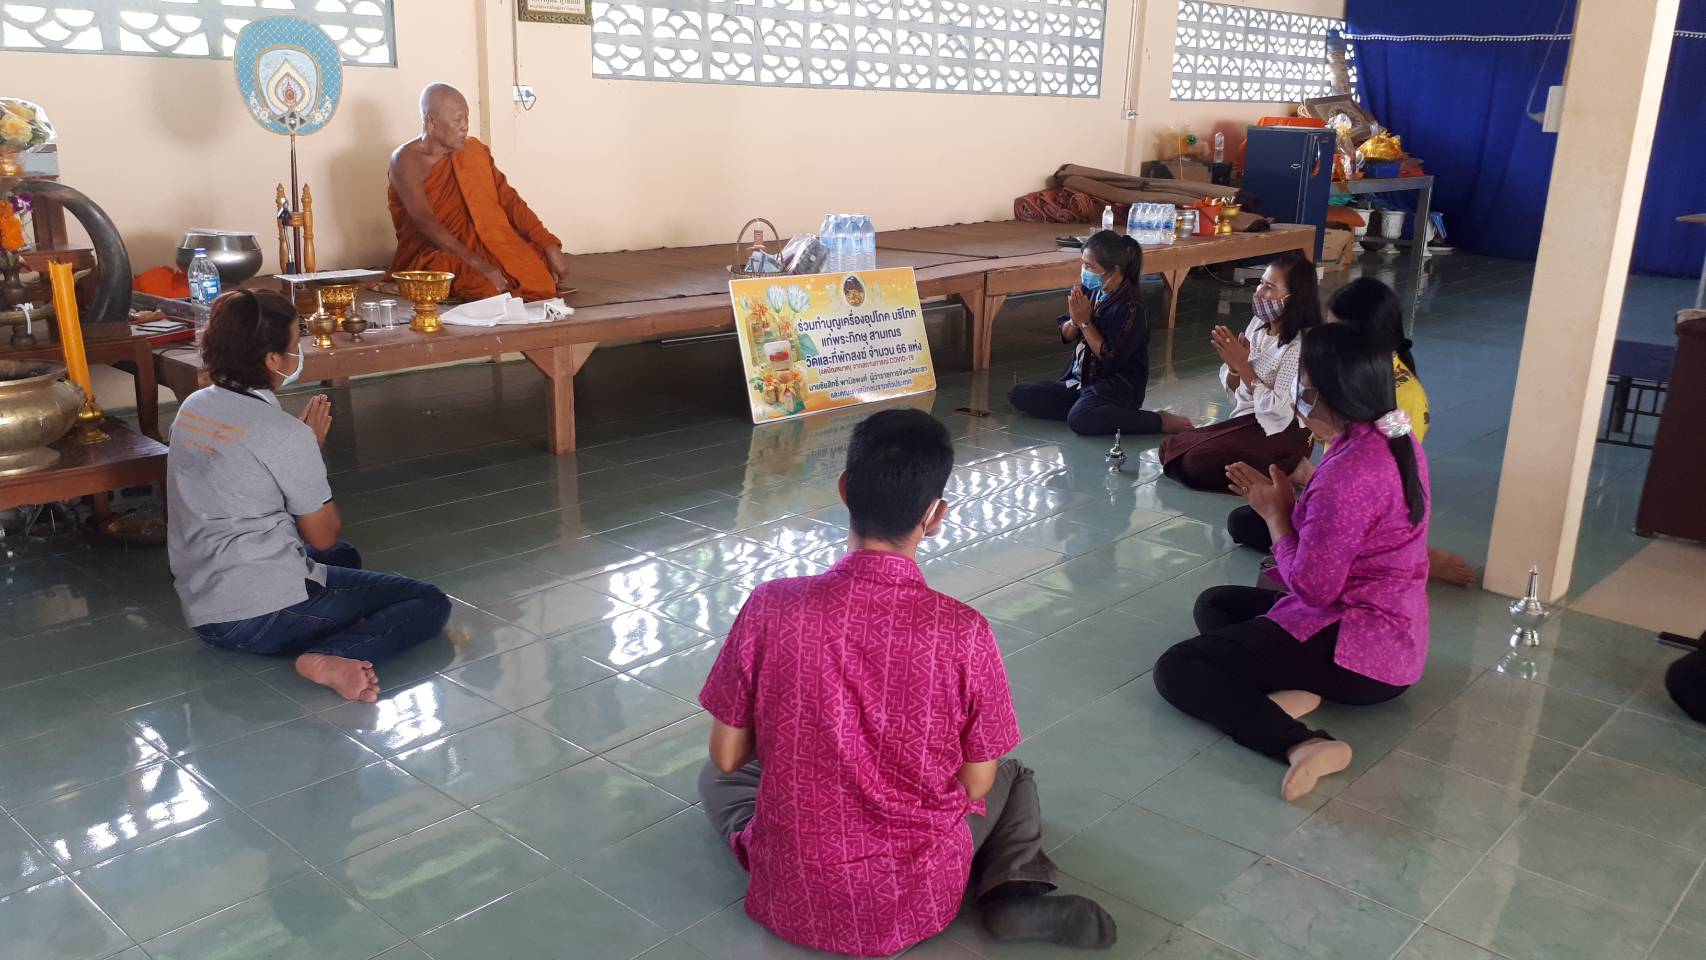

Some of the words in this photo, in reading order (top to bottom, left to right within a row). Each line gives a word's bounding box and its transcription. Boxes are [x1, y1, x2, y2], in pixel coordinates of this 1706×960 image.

[892, 307, 917, 320] บริโภค
[821, 331, 868, 347] แก่พระภิกษุ
[869, 327, 902, 340] สามเณร
[869, 345, 895, 359] จำนวน
[897, 343, 907, 353] 66
[907, 340, 922, 352] แห่ง
